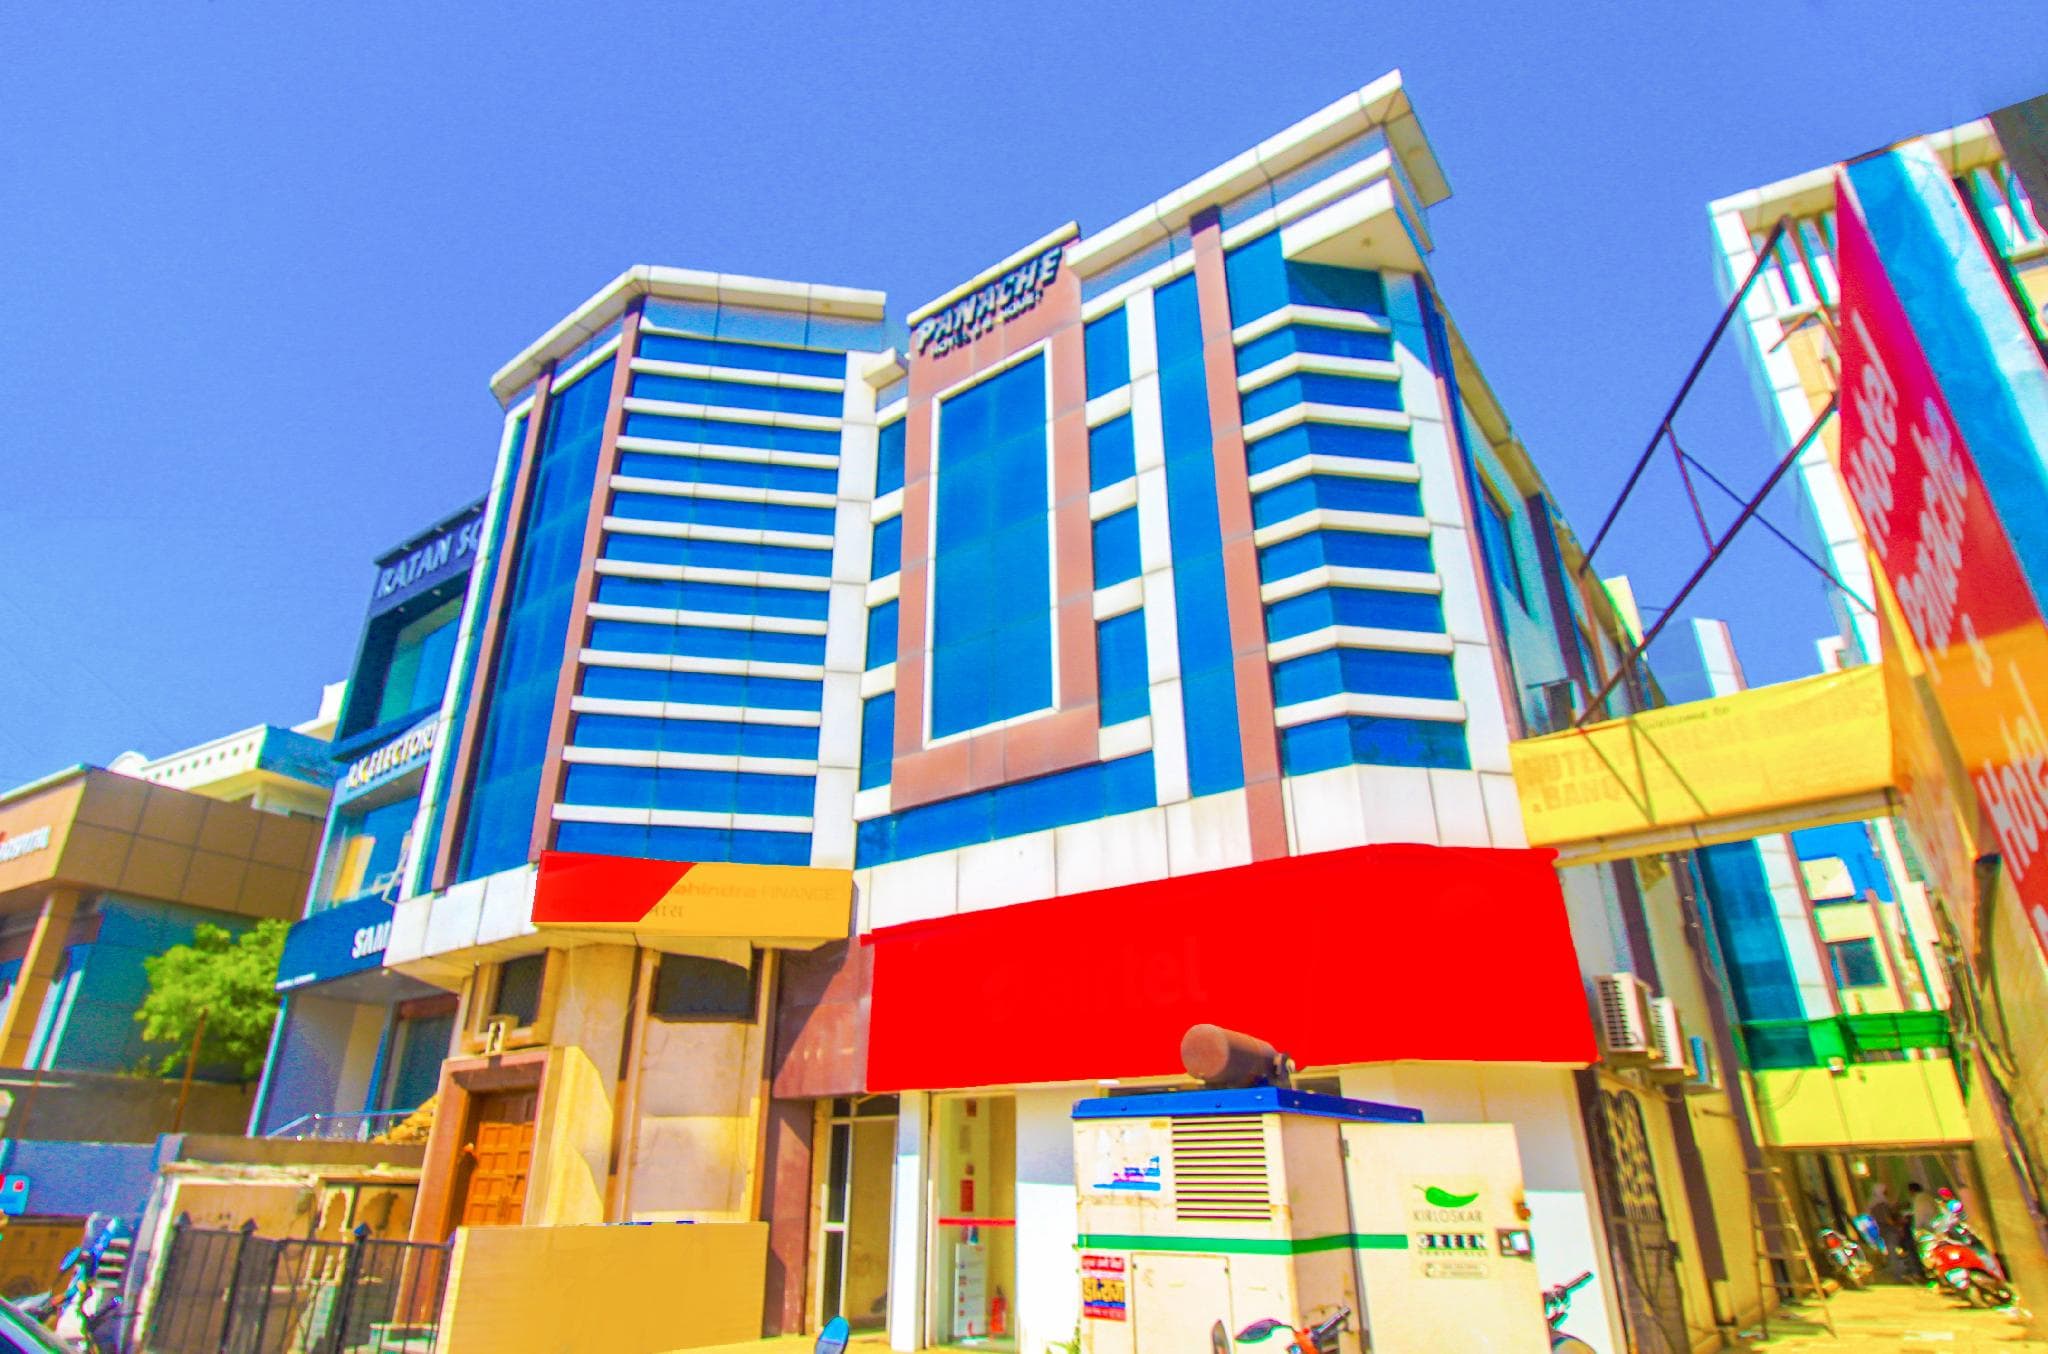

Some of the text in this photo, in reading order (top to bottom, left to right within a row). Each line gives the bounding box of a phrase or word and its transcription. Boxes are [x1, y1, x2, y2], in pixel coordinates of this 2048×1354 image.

[915, 247, 1063, 356] PANACHE
[1848, 309, 1899, 561] Hotel
[376, 533, 453, 598] RATAN
[1897, 396, 1969, 684] Panache
[1413, 1209, 1483, 1223] KIRLOSKAR
[1415, 1232, 1488, 1250] GREEN
